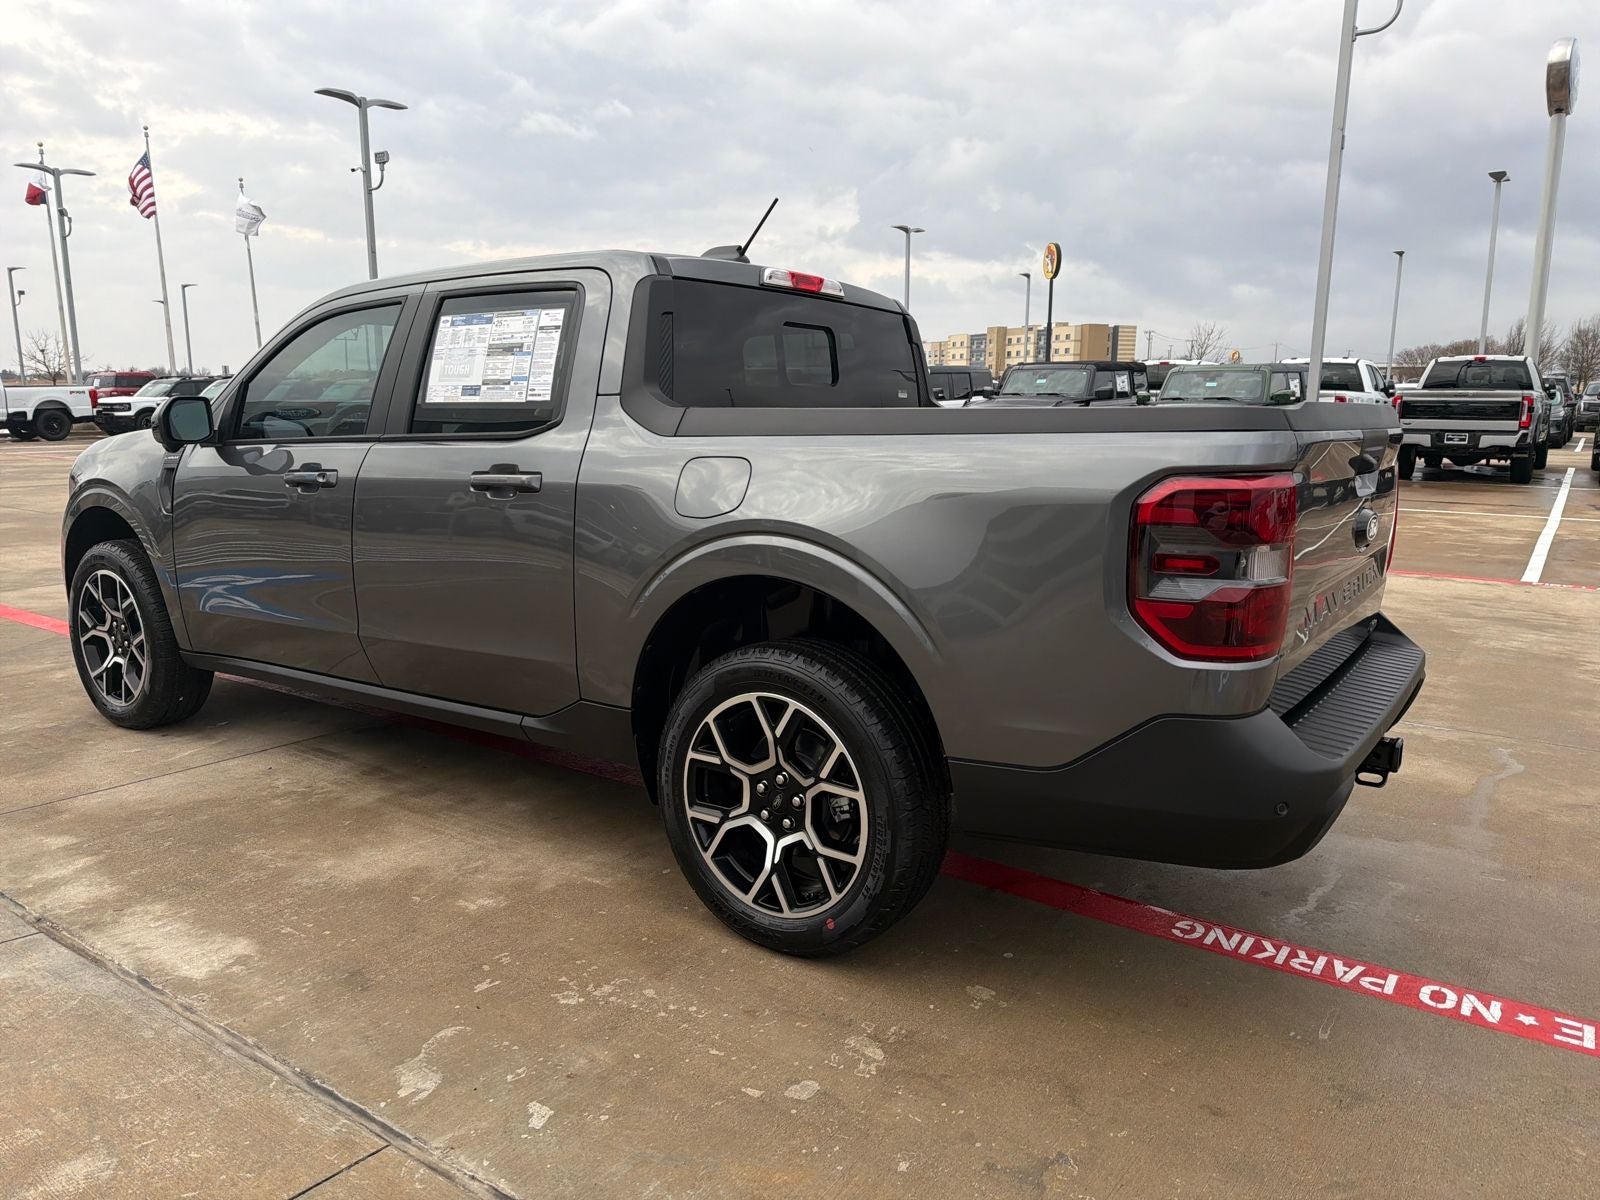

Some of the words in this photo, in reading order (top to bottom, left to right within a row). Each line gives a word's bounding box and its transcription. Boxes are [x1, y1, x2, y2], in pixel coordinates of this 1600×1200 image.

[443, 363, 470, 377] TOUGH
[1171, 919, 1399, 995] PARKING
[1418, 984, 1502, 1024] NO
